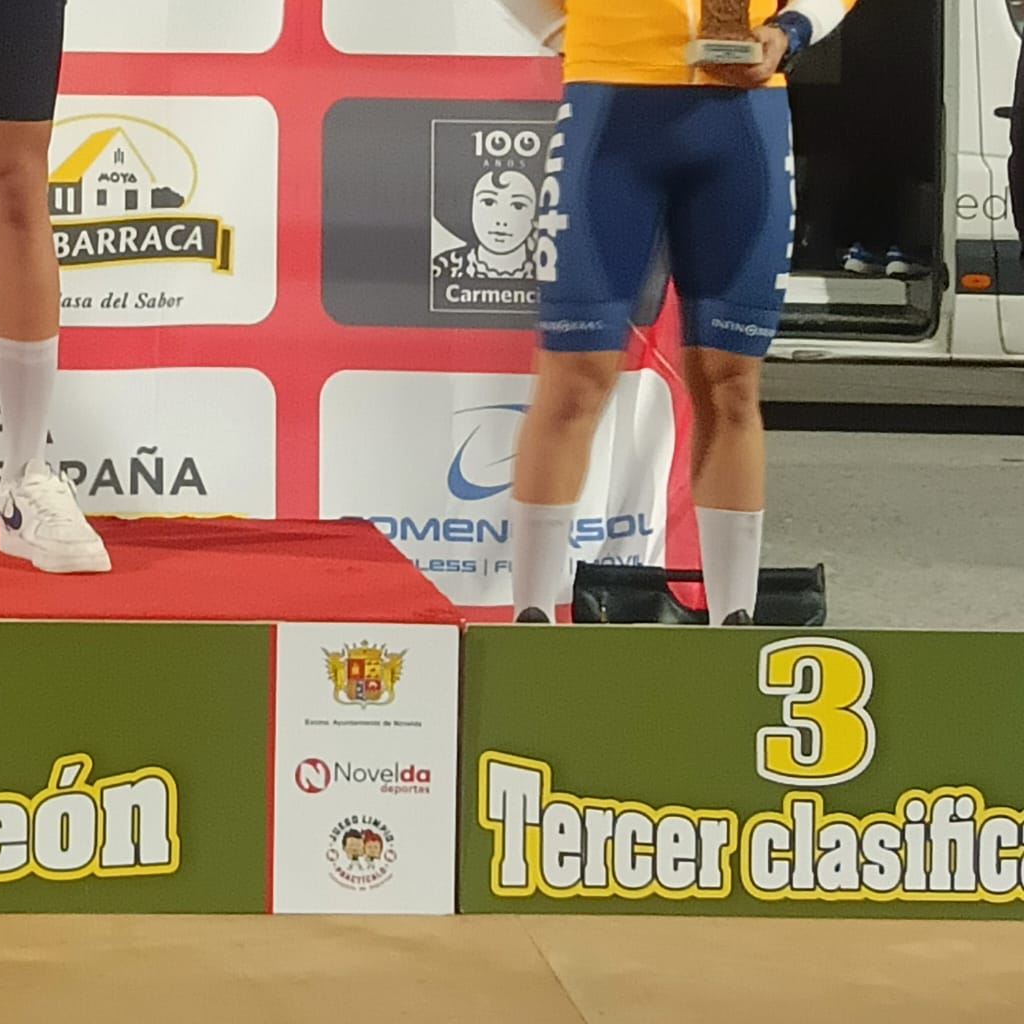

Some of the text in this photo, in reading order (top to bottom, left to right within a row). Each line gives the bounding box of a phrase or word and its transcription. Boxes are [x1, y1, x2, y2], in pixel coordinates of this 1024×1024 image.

[472, 130, 541, 157] 100
[98, 172, 138, 184] MOYA
[54, 224, 203, 259] BARRACA
[59, 292, 184, 309] asa del Sabor
[757, 638, 873, 785] 3
[334, 762, 431, 783] Novelda
[380, 784, 430, 795] deportes
[484, 756, 1024, 897] Tercer clasific
